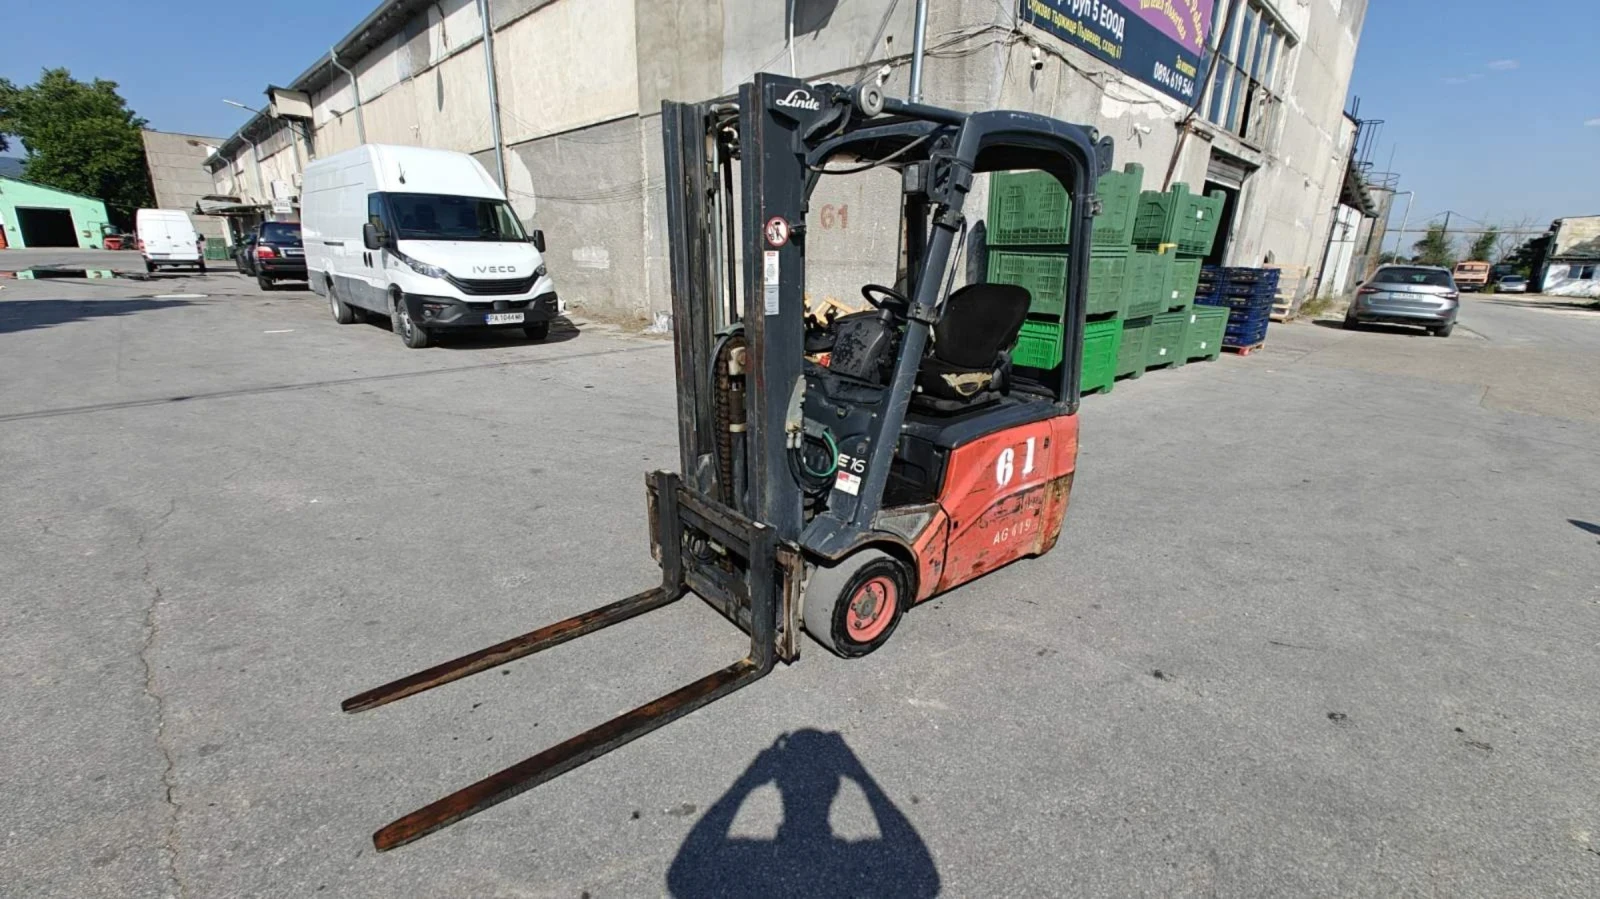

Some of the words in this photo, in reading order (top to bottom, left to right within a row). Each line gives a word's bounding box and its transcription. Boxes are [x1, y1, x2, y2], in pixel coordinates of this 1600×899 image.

[1092, 1, 1100, 21] 5
[1100, 3, 1126, 42] ЕООД
[775, 89, 821, 112] Linde
[820, 204, 848, 231] 61
[472, 265, 516, 274] IVECO
[996, 437, 1036, 487] 61
